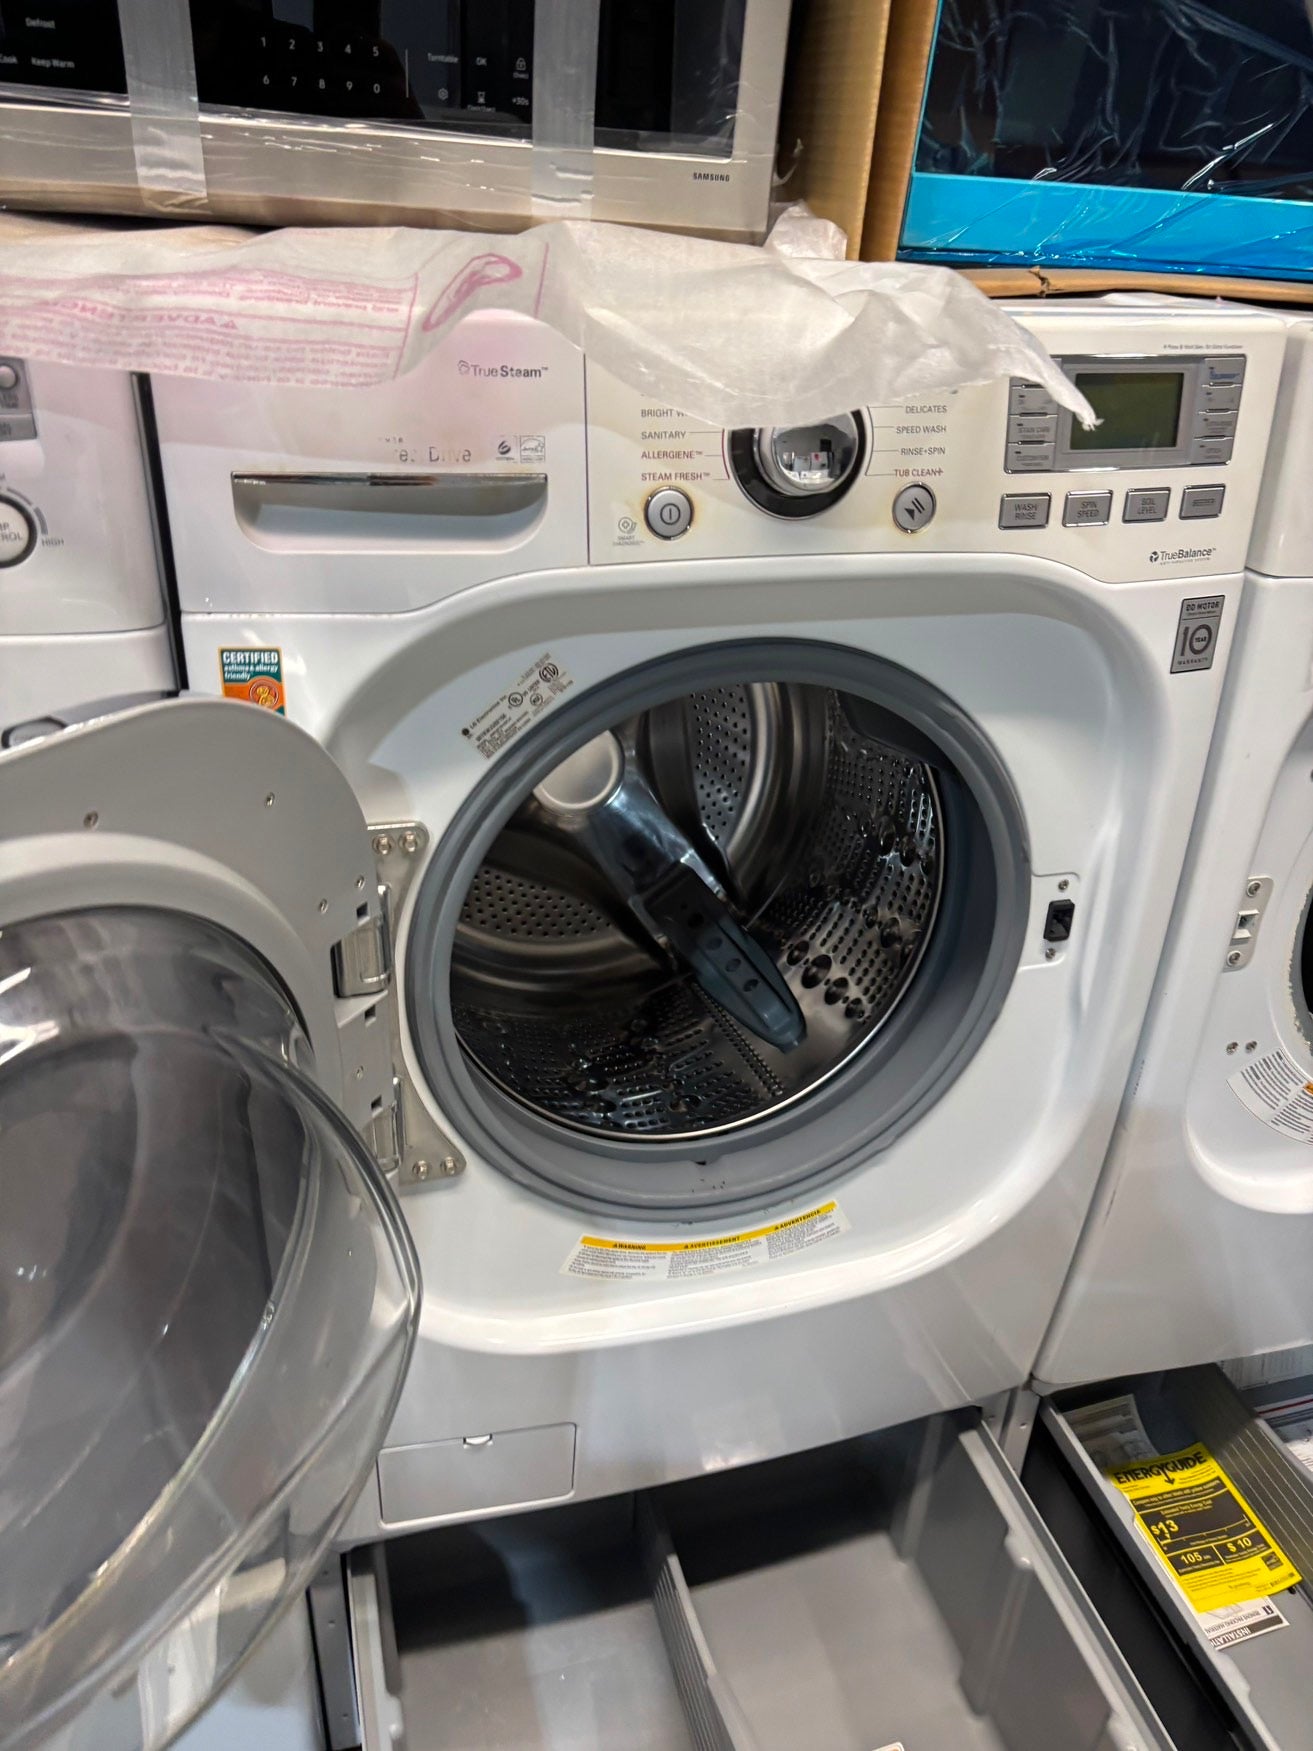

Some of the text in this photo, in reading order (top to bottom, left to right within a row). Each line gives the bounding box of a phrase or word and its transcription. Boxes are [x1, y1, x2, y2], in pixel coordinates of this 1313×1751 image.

[261, 36, 379, 57] 1 2 3 4 5
[263, 74, 381, 94] 6 7 8 9 0
[692, 172, 730, 182] SAMSUNG
[640, 409, 674, 418] BRIGHT
[905, 404, 948, 414] DELICATES
[896, 424, 947, 434] SPEED WASH
[641, 430, 686, 440] SANITARY
[641, 472, 672, 482] STEAM
[894, 468, 910, 477] TUB
[1081, 501, 1097, 509] SPIN
[1076, 509, 1099, 518] SPEED
[1197, 602, 1220, 611] MOTOR
[1180, 624, 1212, 656] 10
[222, 651, 278, 664] CERTIFIED
[255, 664, 278, 673] allergy
[1113, 1451, 1208, 1484] ENERGYGUIDE
[1150, 1519, 1179, 1535] $13
[1237, 1537, 1252, 1548] 10
[1180, 1552, 1202, 1565] 105
